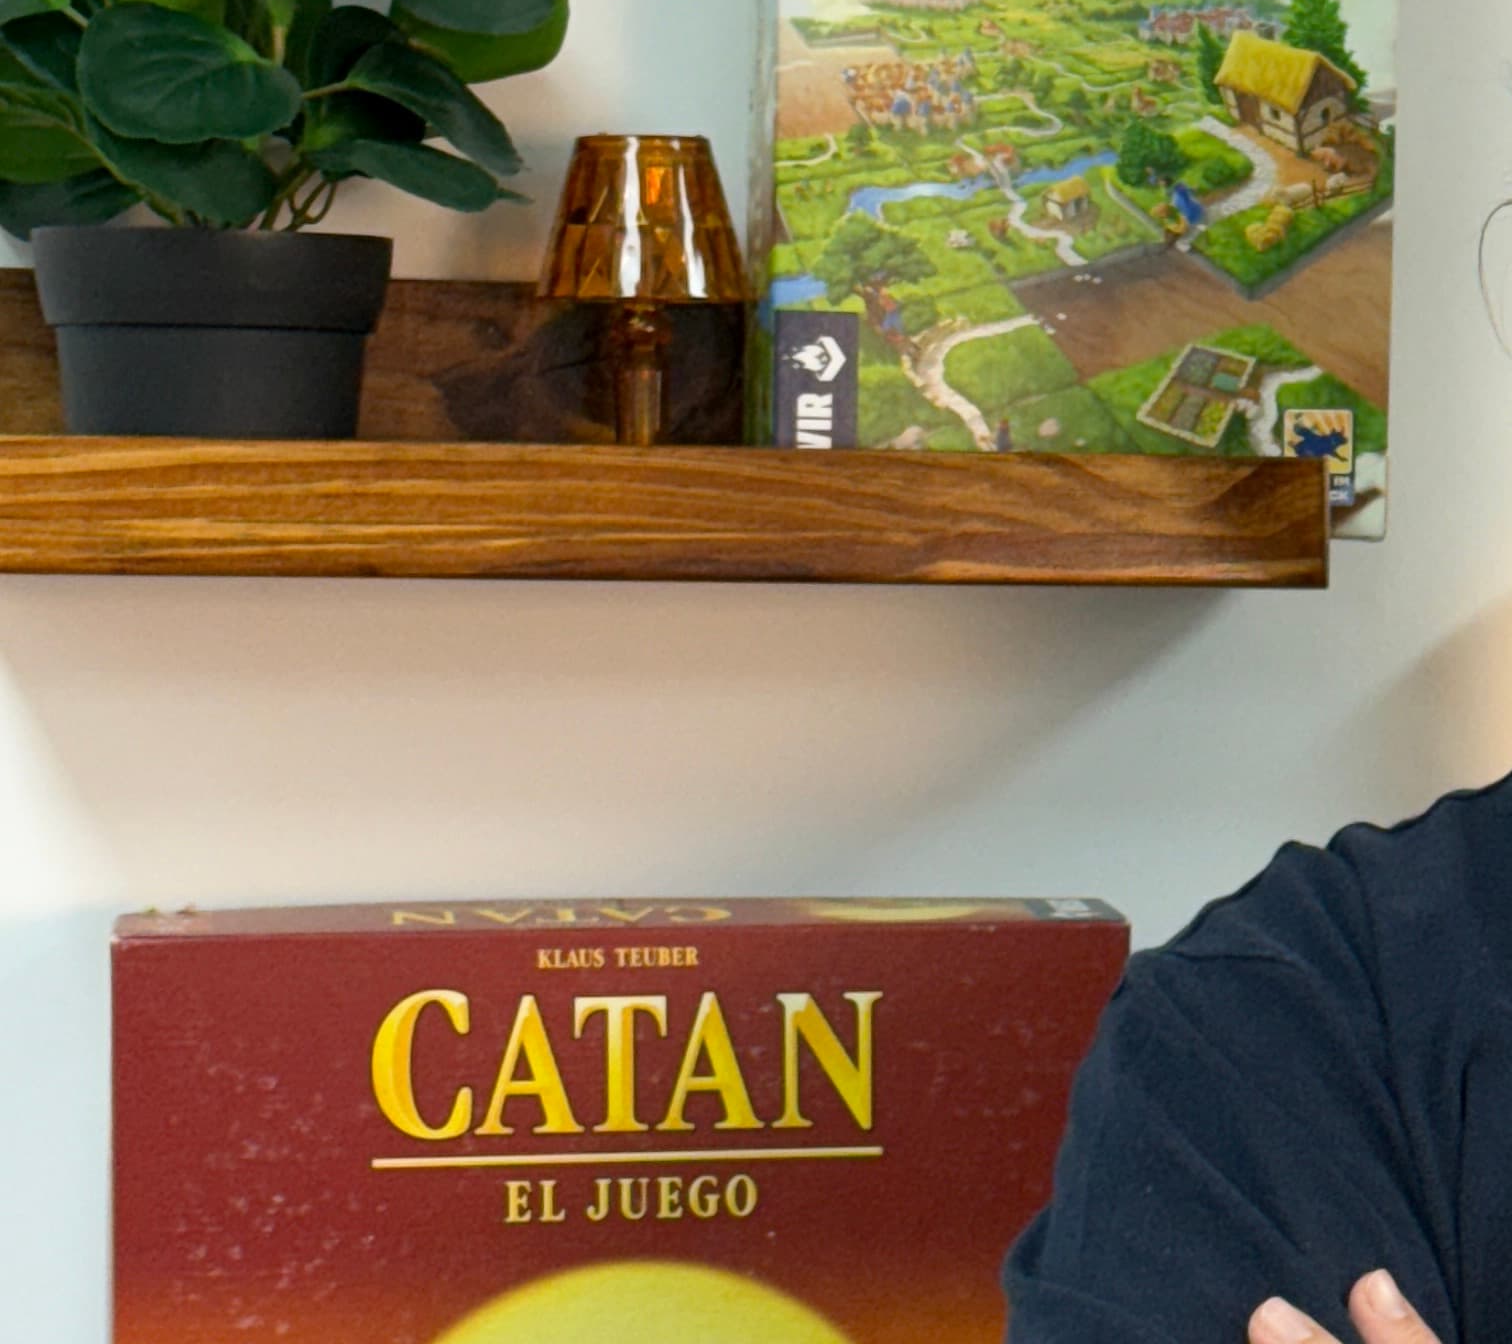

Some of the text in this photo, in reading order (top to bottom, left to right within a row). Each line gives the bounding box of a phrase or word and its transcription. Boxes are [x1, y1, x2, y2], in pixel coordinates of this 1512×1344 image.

[796, 393, 833, 450] VIR
[391, 905, 732, 926] CATAN
[537, 946, 699, 969] KLAUS TEUBER
[371, 988, 884, 1141] CATAN
[504, 1173, 759, 1224] EL JUEGO
